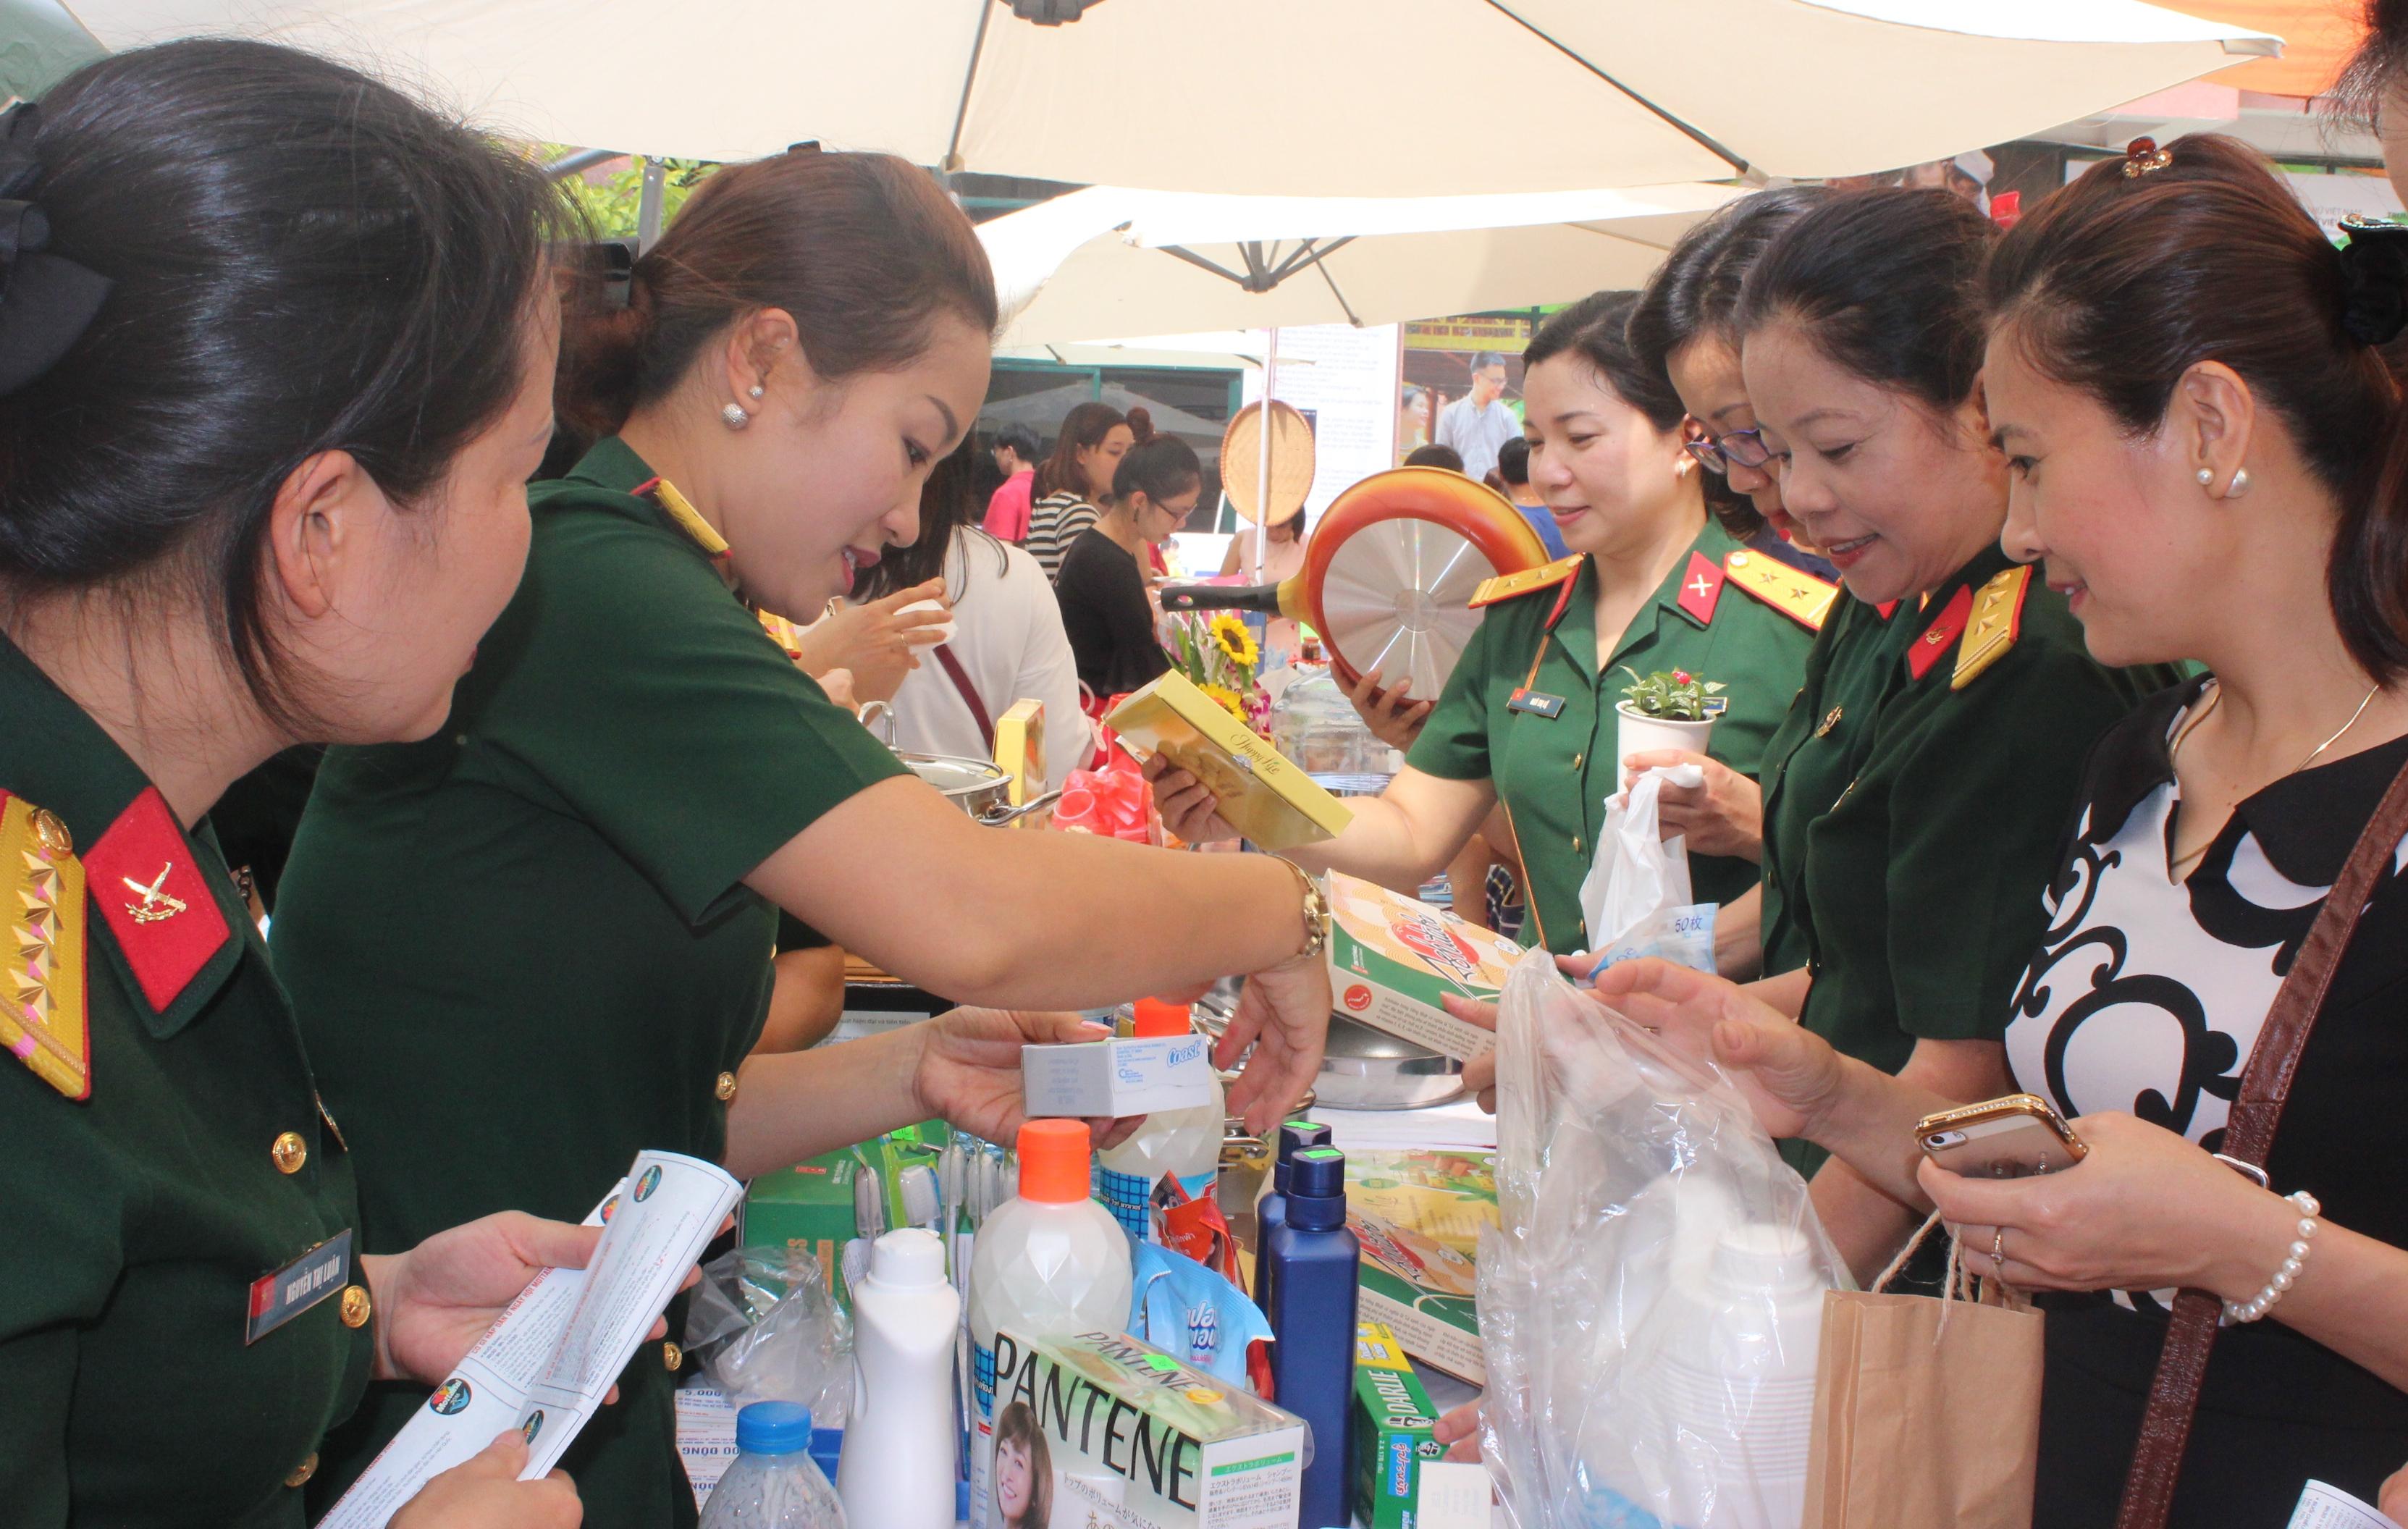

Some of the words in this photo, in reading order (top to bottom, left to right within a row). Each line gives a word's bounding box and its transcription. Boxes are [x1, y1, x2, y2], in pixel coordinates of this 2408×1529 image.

[1230, 734, 1265, 764] Happy
[1675, 916, 1702, 933] 50枚
[1167, 1040, 1201, 1067] Coast
[436, 1379, 463, 1413] Mottainai
[1368, 1369, 1420, 1415] DARLIE
[994, 1331, 1203, 1512] PANTENE
[1225, 1456, 1283, 1473] エクストラボリューム
[1210, 1473, 1261, 1489] エクストラボリューム
